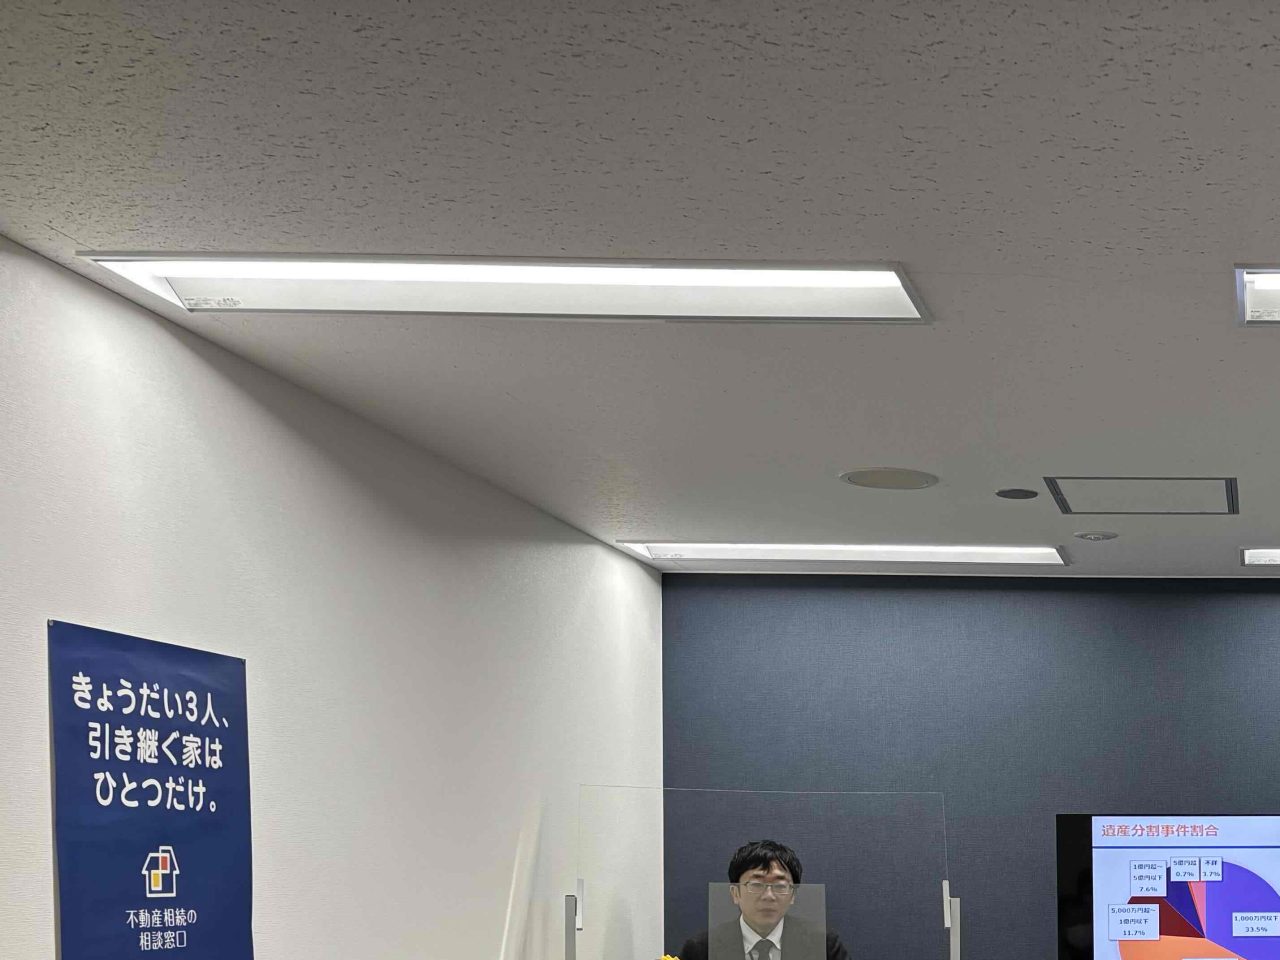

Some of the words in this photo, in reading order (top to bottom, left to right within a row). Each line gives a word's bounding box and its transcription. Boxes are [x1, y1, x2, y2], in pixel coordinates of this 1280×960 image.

[72, 672, 228, 727] きょうだい3人、
[88, 722, 223, 769] 引き継ぐ家は
[94, 771, 216, 812] ひとつだけ。
[1101, 824, 1219, 837] 遺産分割事件割合
[125, 908, 197, 928] 不動産相続の
[139, 931, 187, 950] 相談窓口
